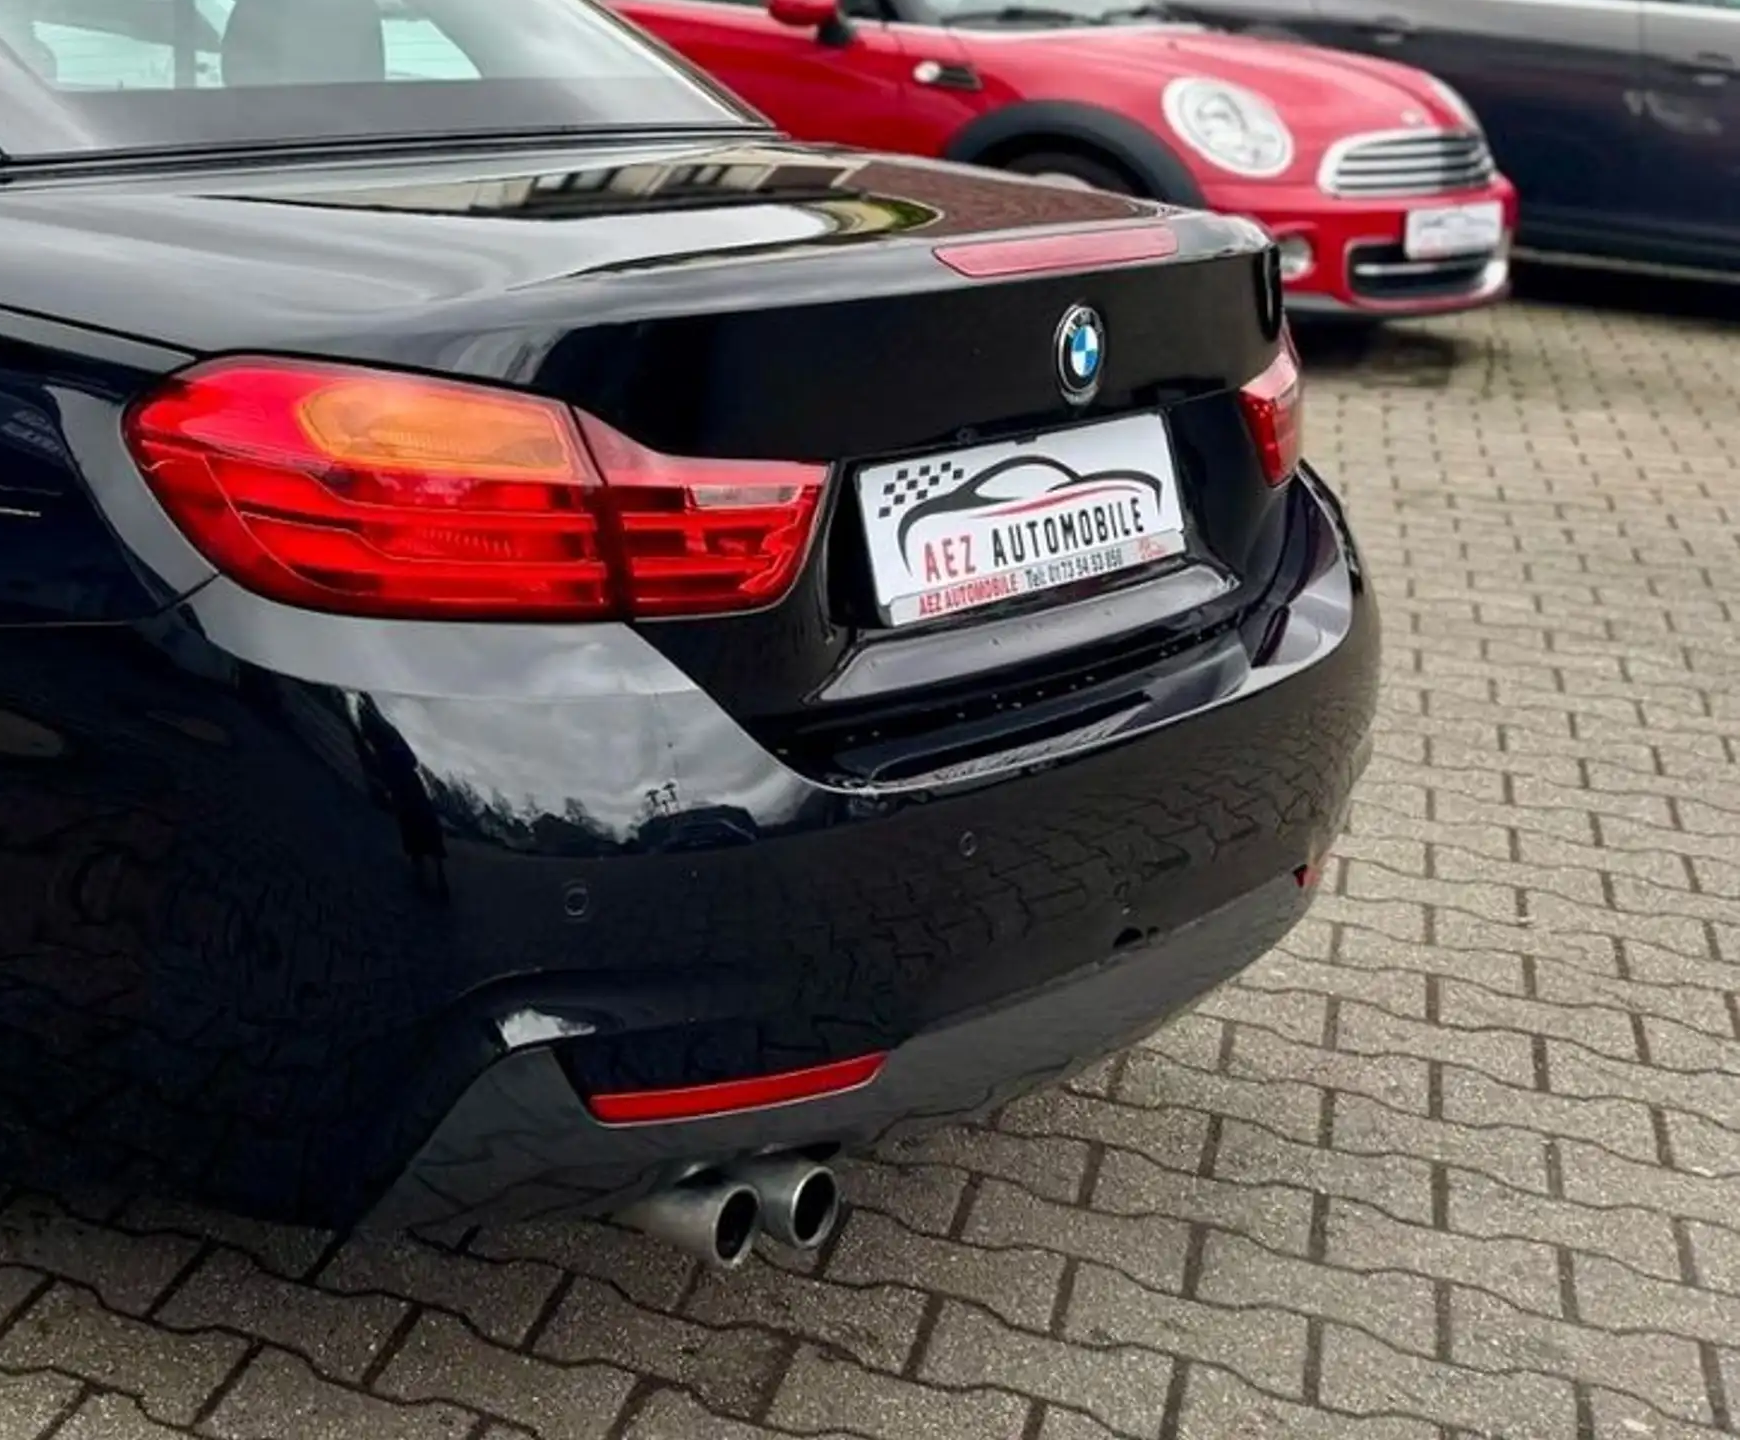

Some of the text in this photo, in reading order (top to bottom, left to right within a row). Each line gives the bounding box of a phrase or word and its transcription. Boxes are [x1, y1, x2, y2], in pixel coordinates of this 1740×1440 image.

[924, 497, 1144, 582] AEZ AUTOMOBILE
[944, 572, 1019, 606] AUTOMOBILE
